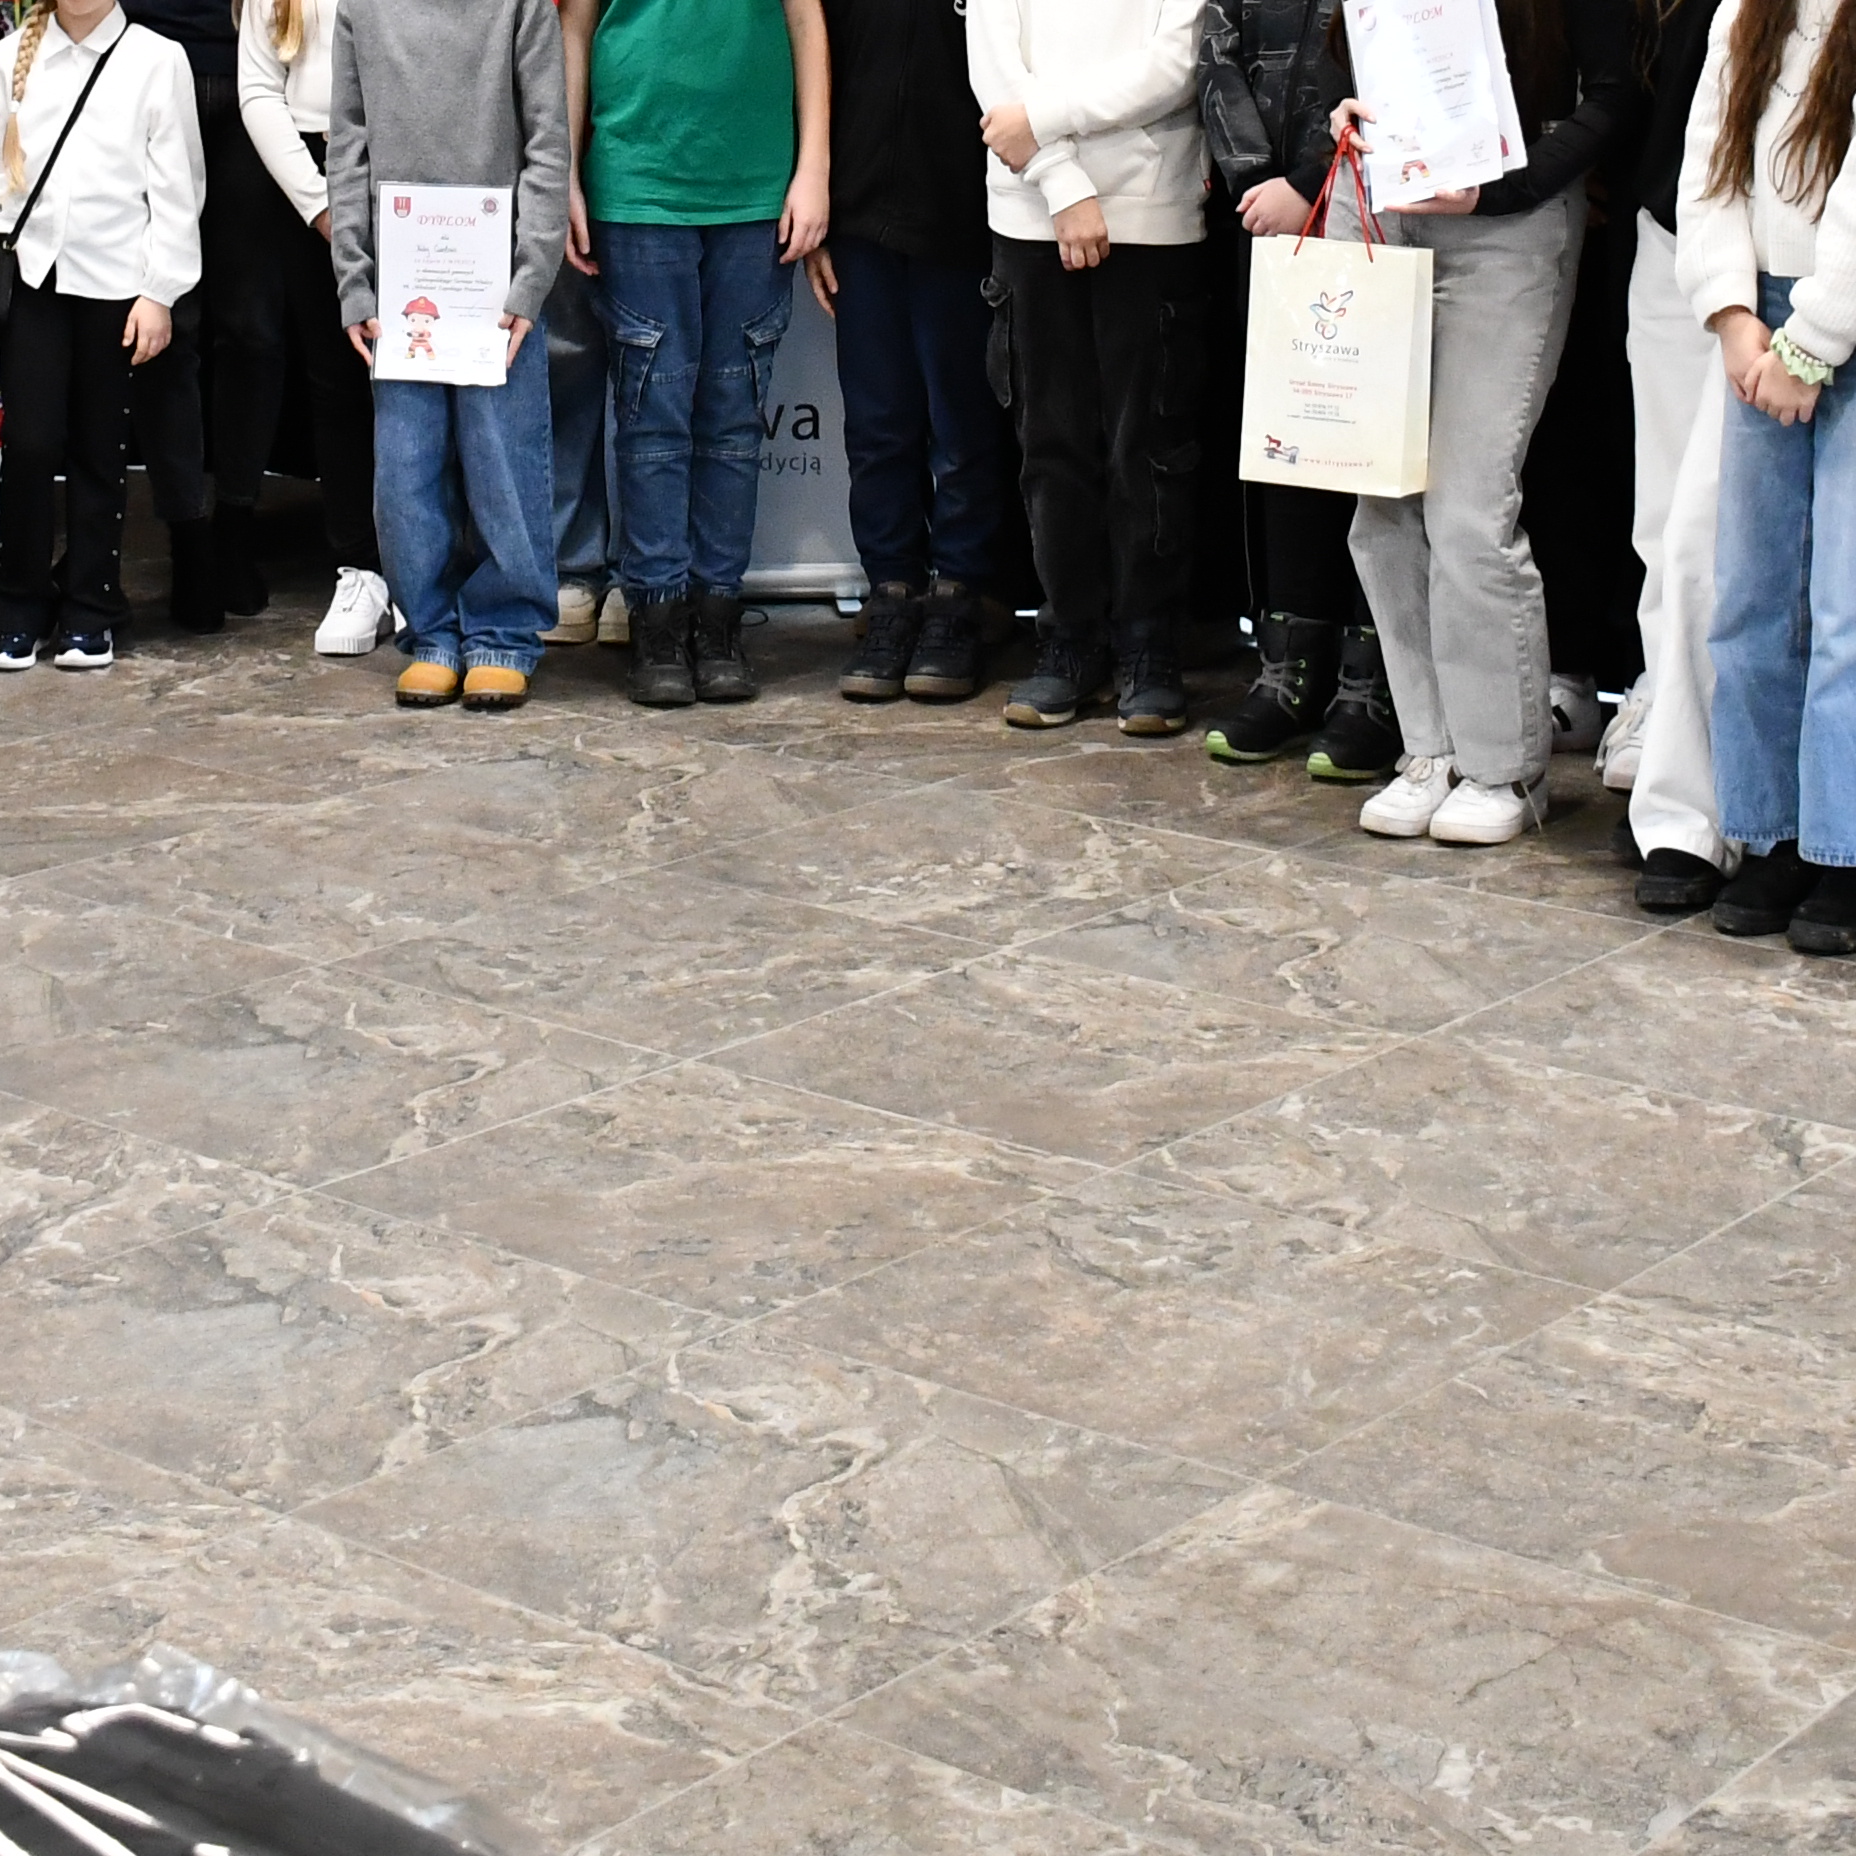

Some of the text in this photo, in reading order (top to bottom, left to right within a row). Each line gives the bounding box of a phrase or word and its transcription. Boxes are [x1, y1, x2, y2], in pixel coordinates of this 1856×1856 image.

[417, 215, 477, 227] DYPLOM
[1292, 338, 1360, 356] Stryszawa
[760, 452, 821, 475] dycją
